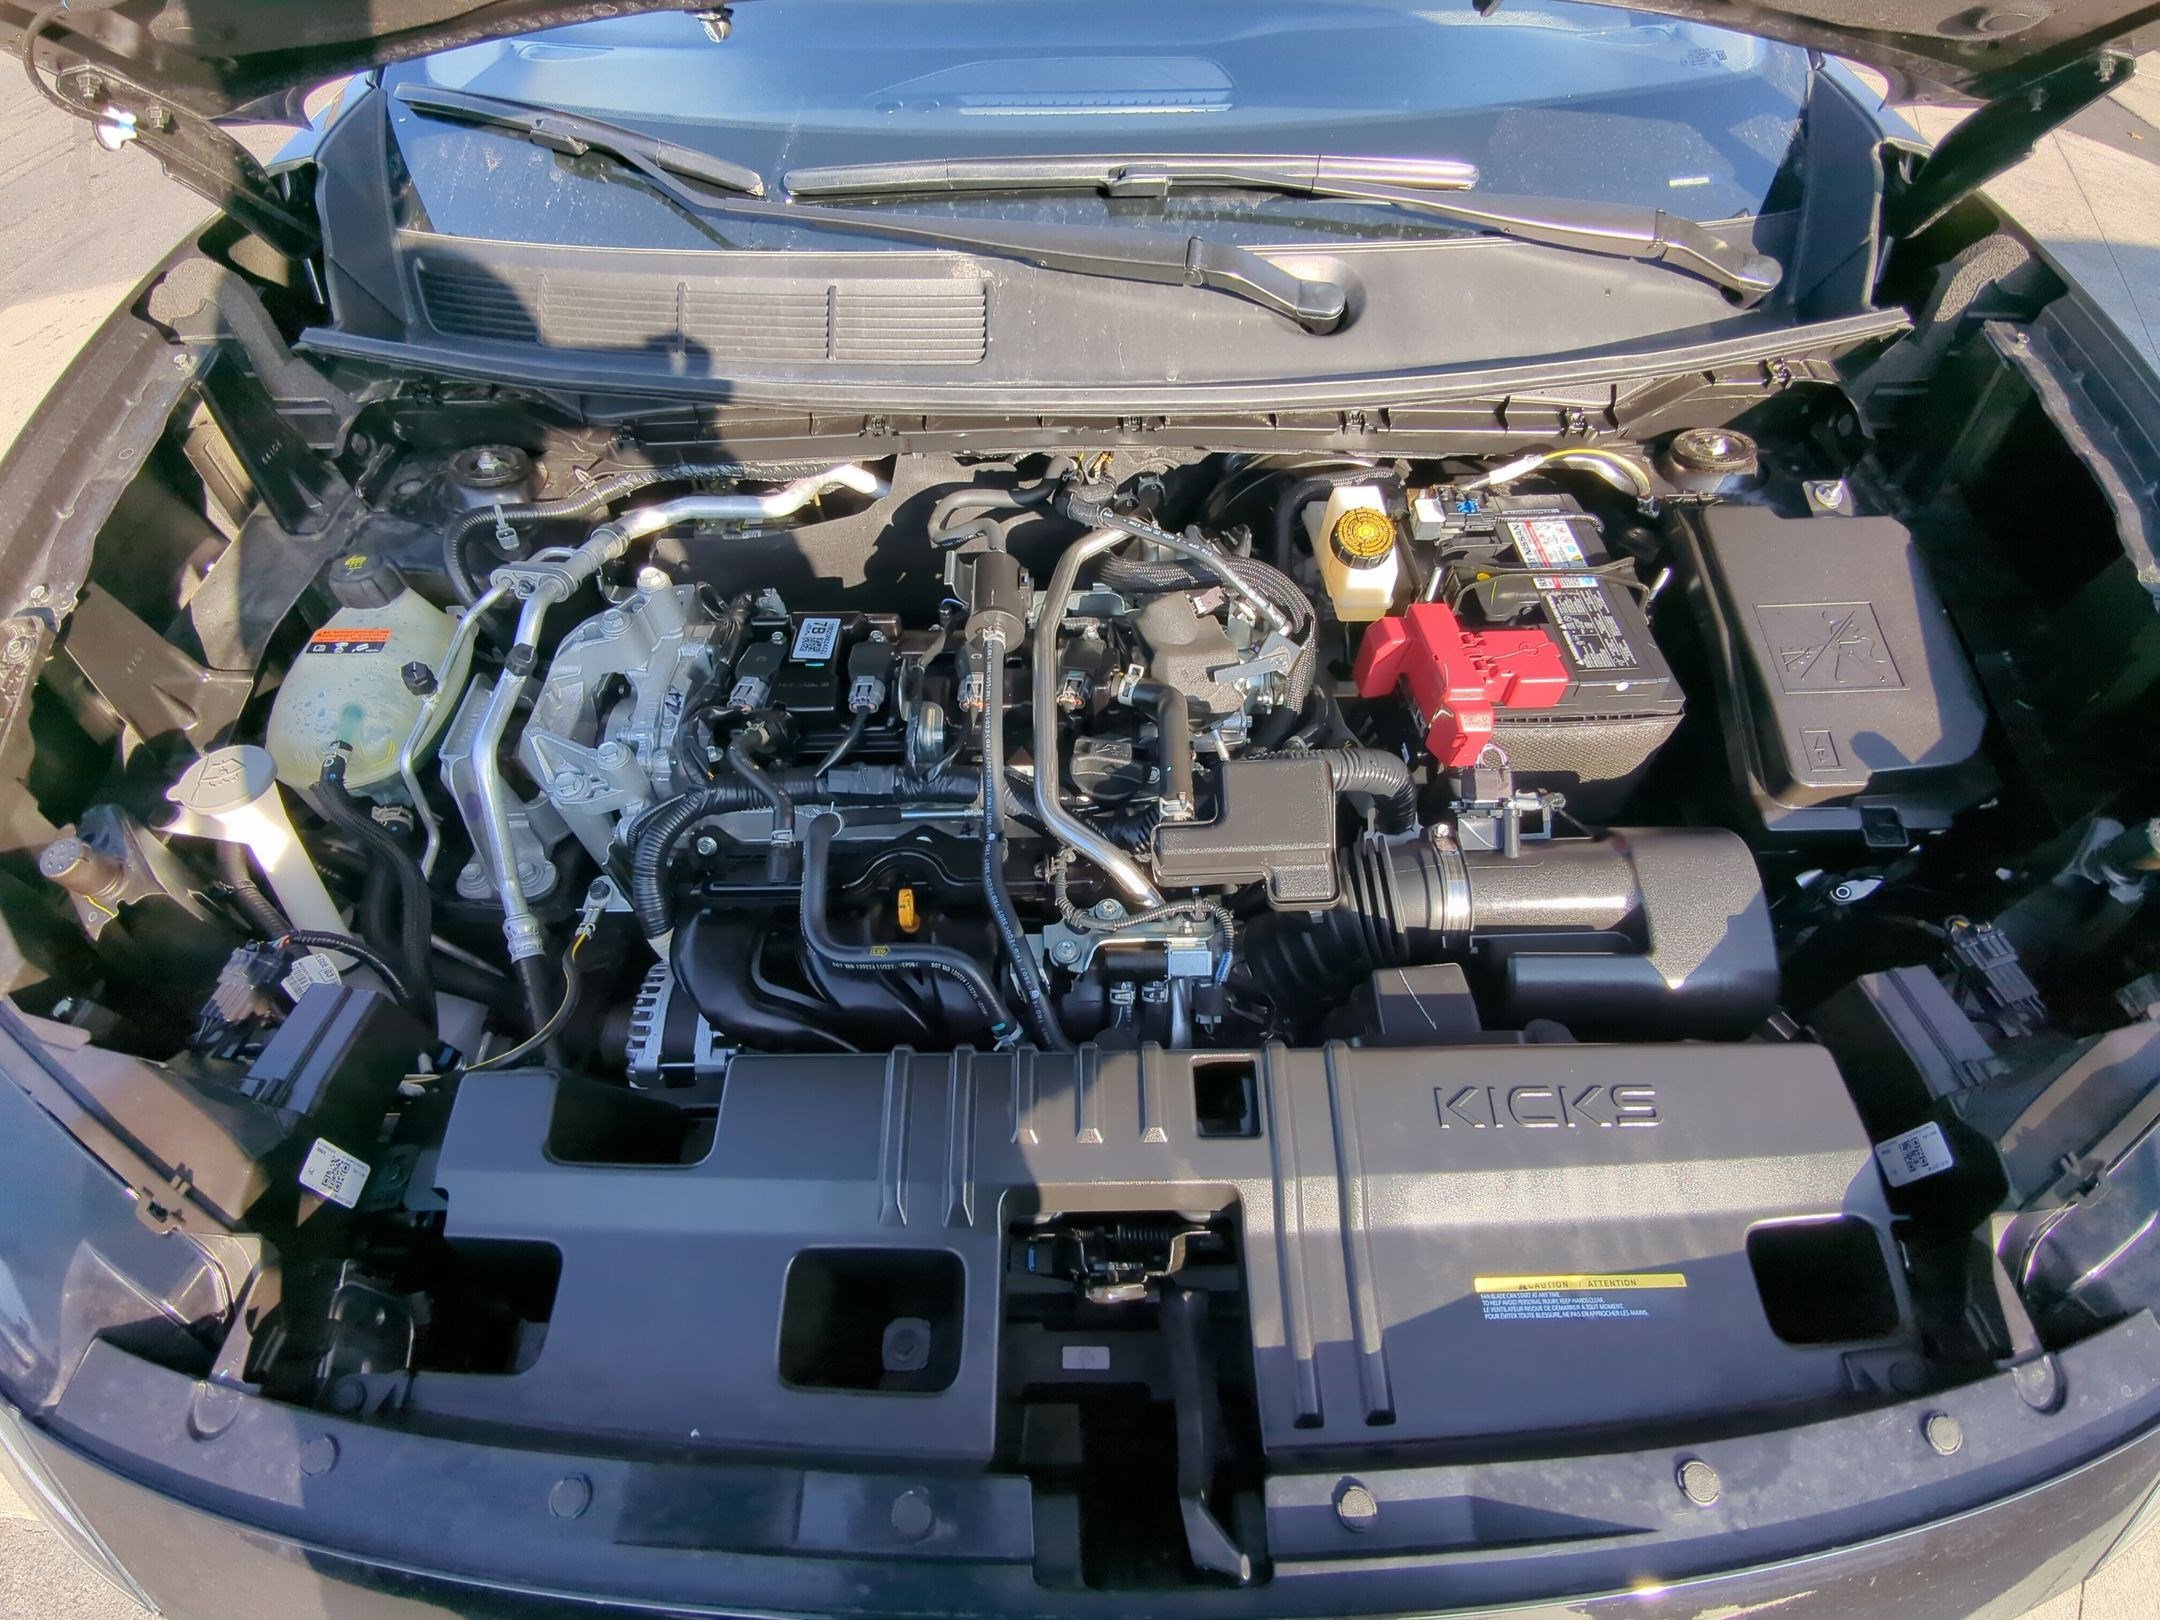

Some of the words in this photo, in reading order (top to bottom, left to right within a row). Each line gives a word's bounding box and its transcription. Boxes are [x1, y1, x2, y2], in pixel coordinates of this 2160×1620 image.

[1511, 524, 1531, 555] NISSAN
[1433, 1083, 1664, 1129] KICKS
[1528, 1281, 1569, 1289] CAUTION
[1588, 1279, 1637, 1288] ATTENTION
